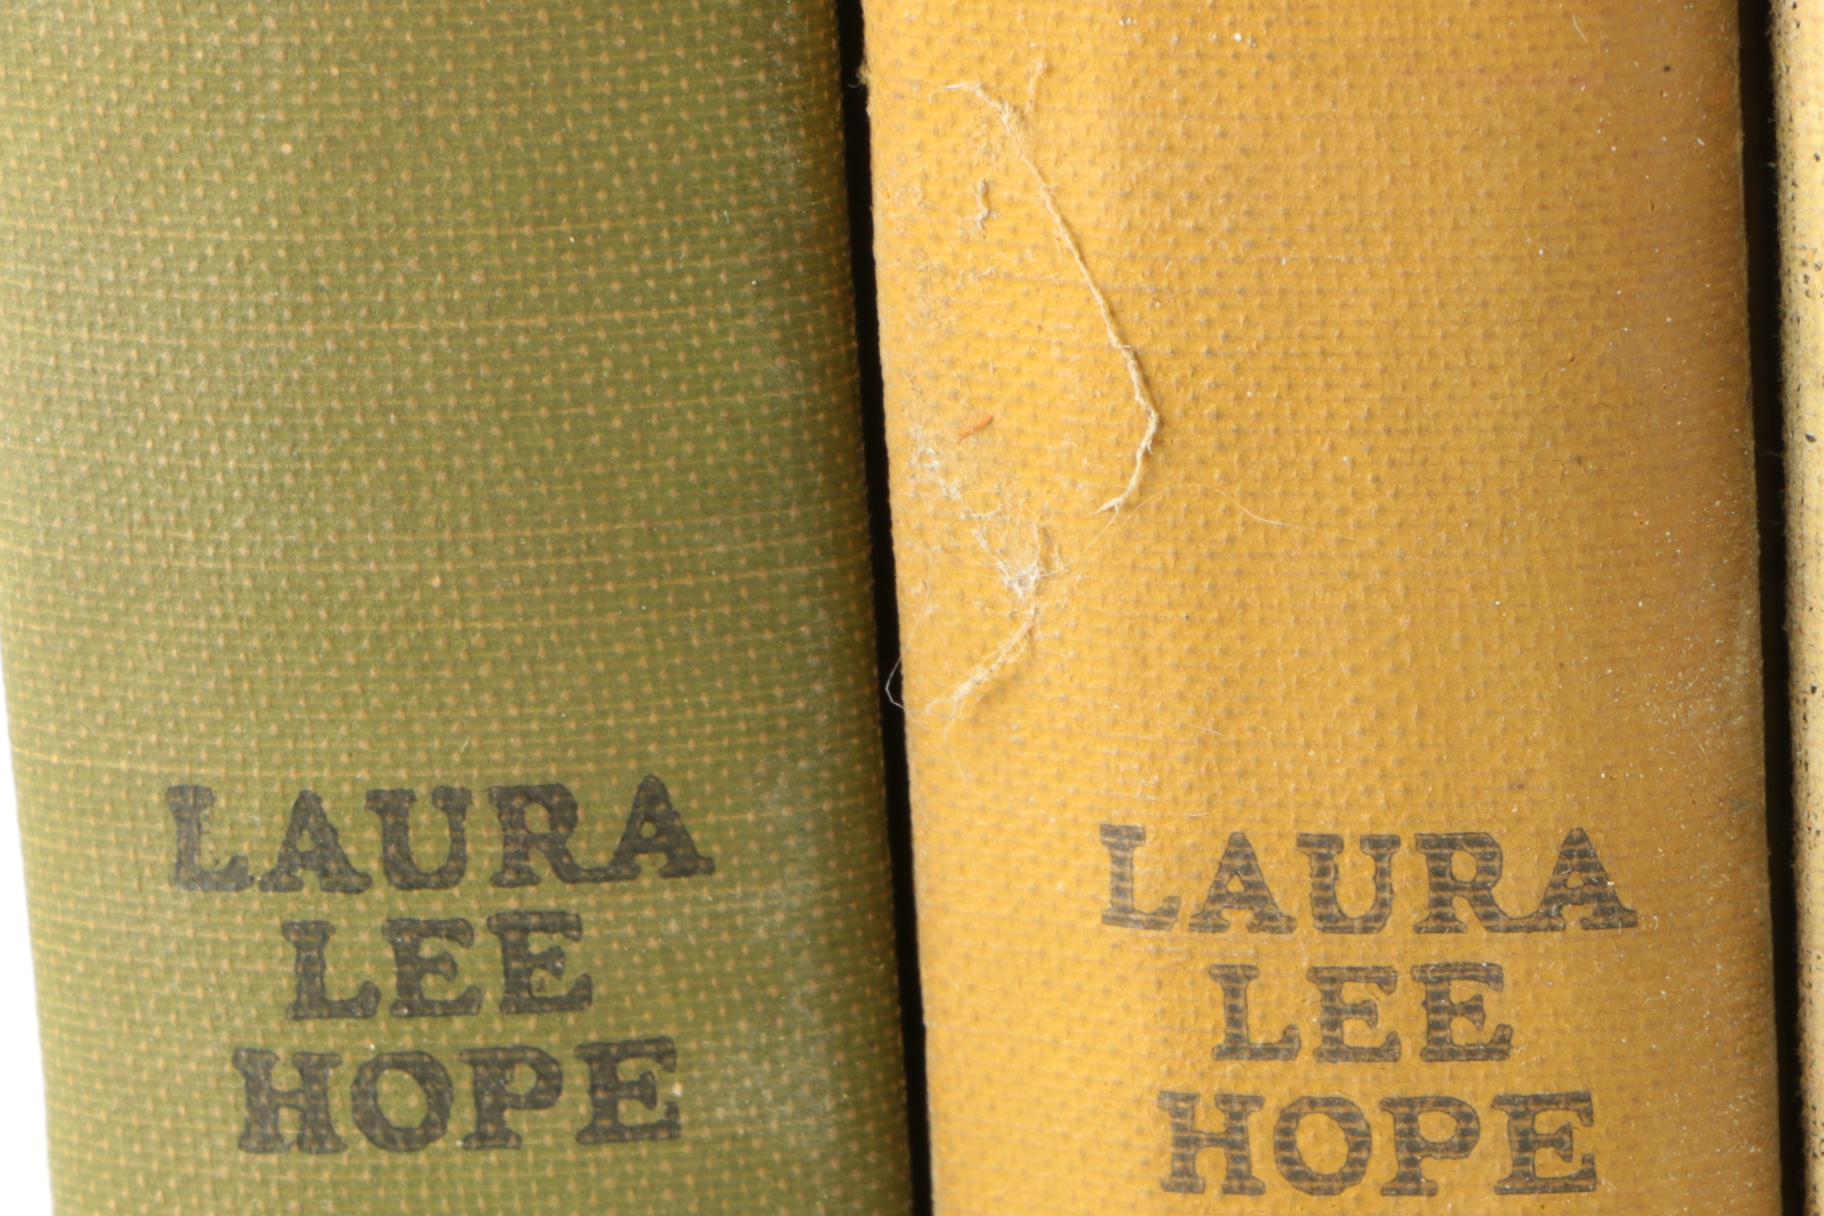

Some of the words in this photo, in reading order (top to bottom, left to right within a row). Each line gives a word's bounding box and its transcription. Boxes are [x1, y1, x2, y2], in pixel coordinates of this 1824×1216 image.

[166, 774, 715, 893] LAURA
[1100, 824, 1639, 934] LAURA
[281, 910, 593, 1020] LEE
[1208, 962, 1514, 1062] LEE
[232, 1036, 681, 1154] HOPE
[1157, 1090, 1596, 1196] HOPE
